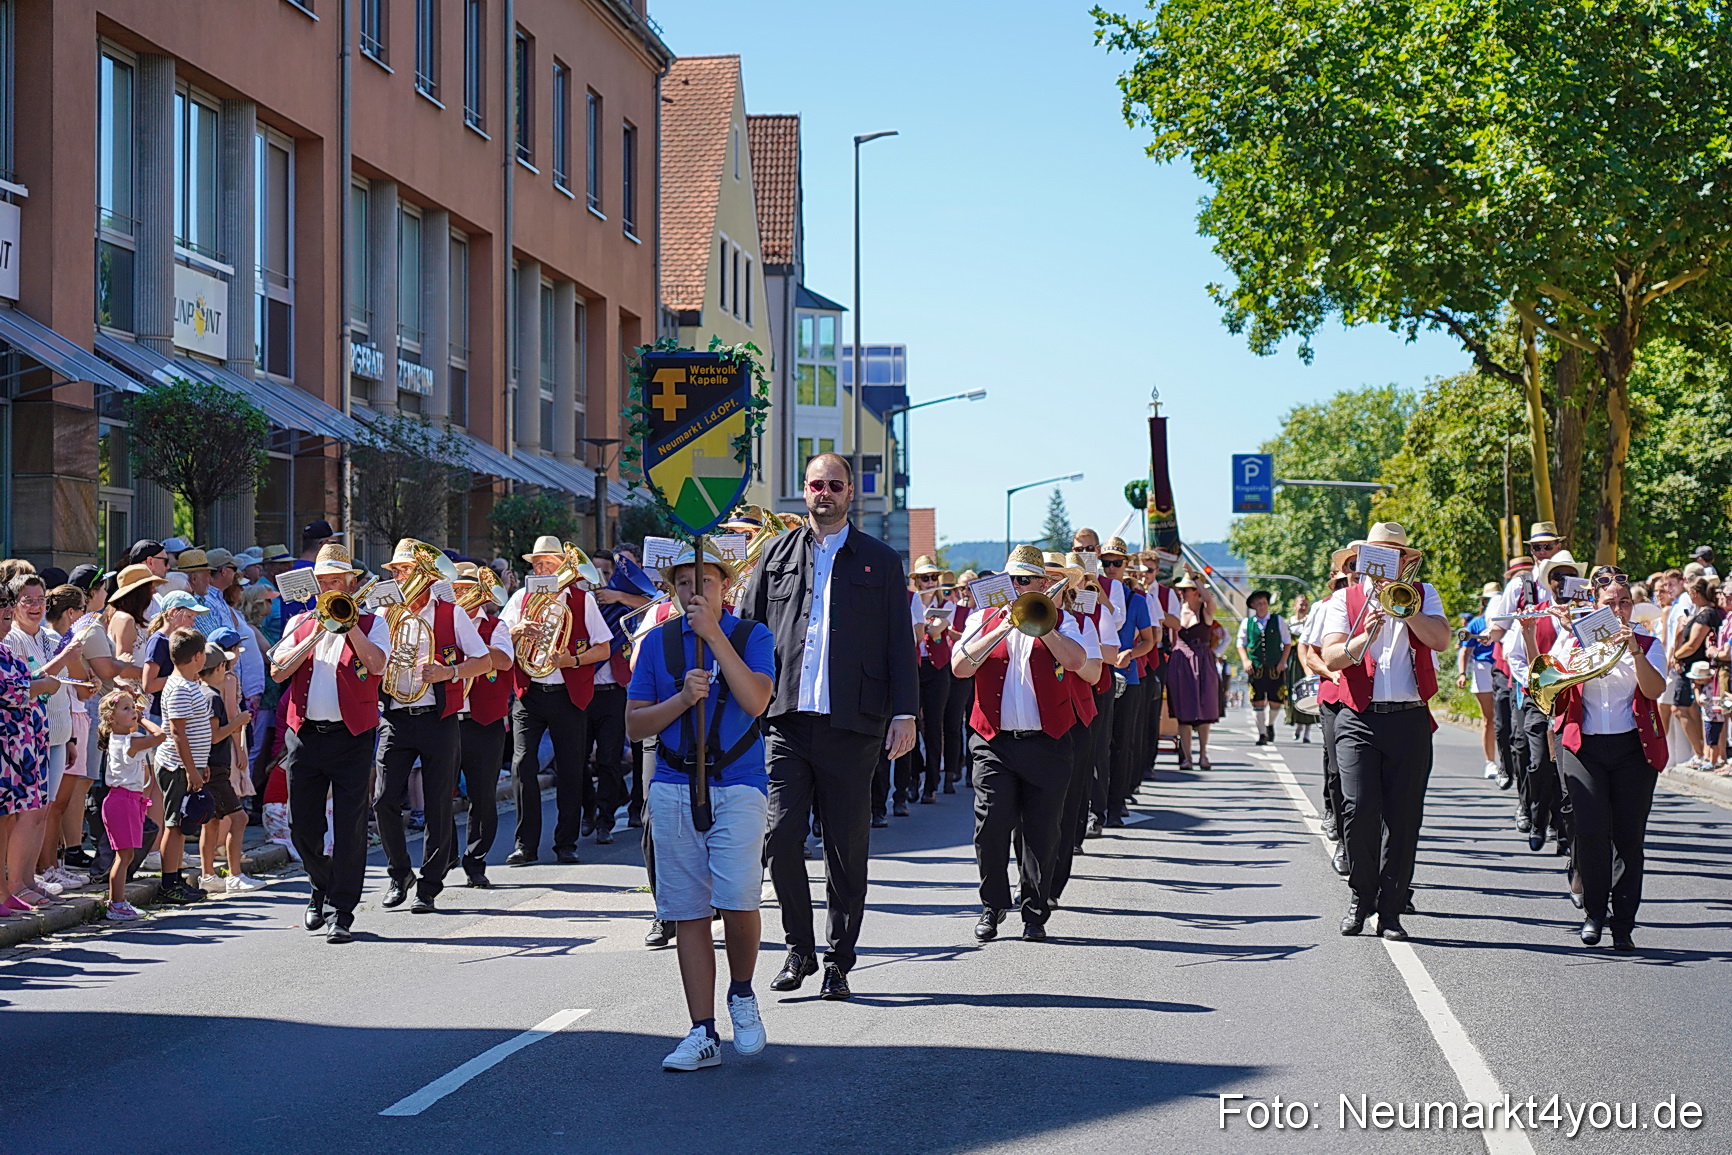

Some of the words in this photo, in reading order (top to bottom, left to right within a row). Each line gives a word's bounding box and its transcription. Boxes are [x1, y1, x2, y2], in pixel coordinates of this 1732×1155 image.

[690, 365, 737, 375] Werkvolk
[690, 375, 729, 386] Kapelle
[658, 422, 702, 456] Neumarkt
[1245, 464, 1260, 485] P
